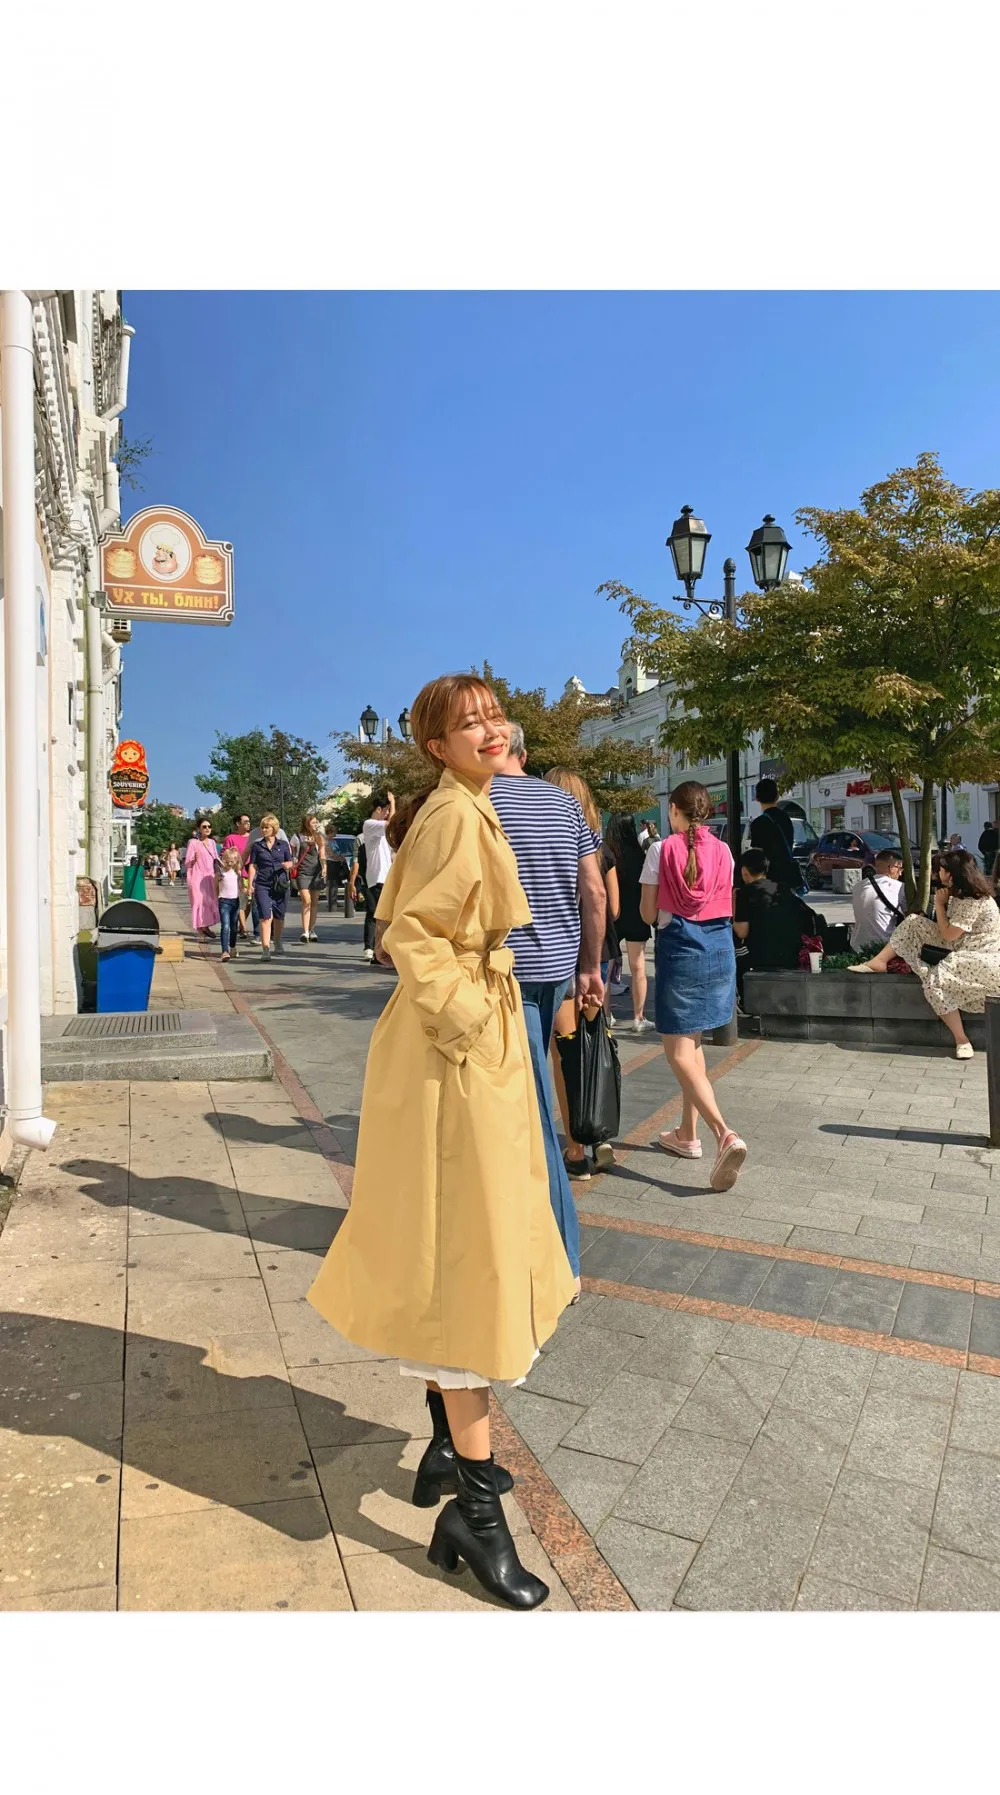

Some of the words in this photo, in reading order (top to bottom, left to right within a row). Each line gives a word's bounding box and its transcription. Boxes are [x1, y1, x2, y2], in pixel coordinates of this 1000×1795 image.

[112, 588, 135, 604] Ух
[141, 592, 168, 607] ты,
[174, 592, 218, 609] блин!
